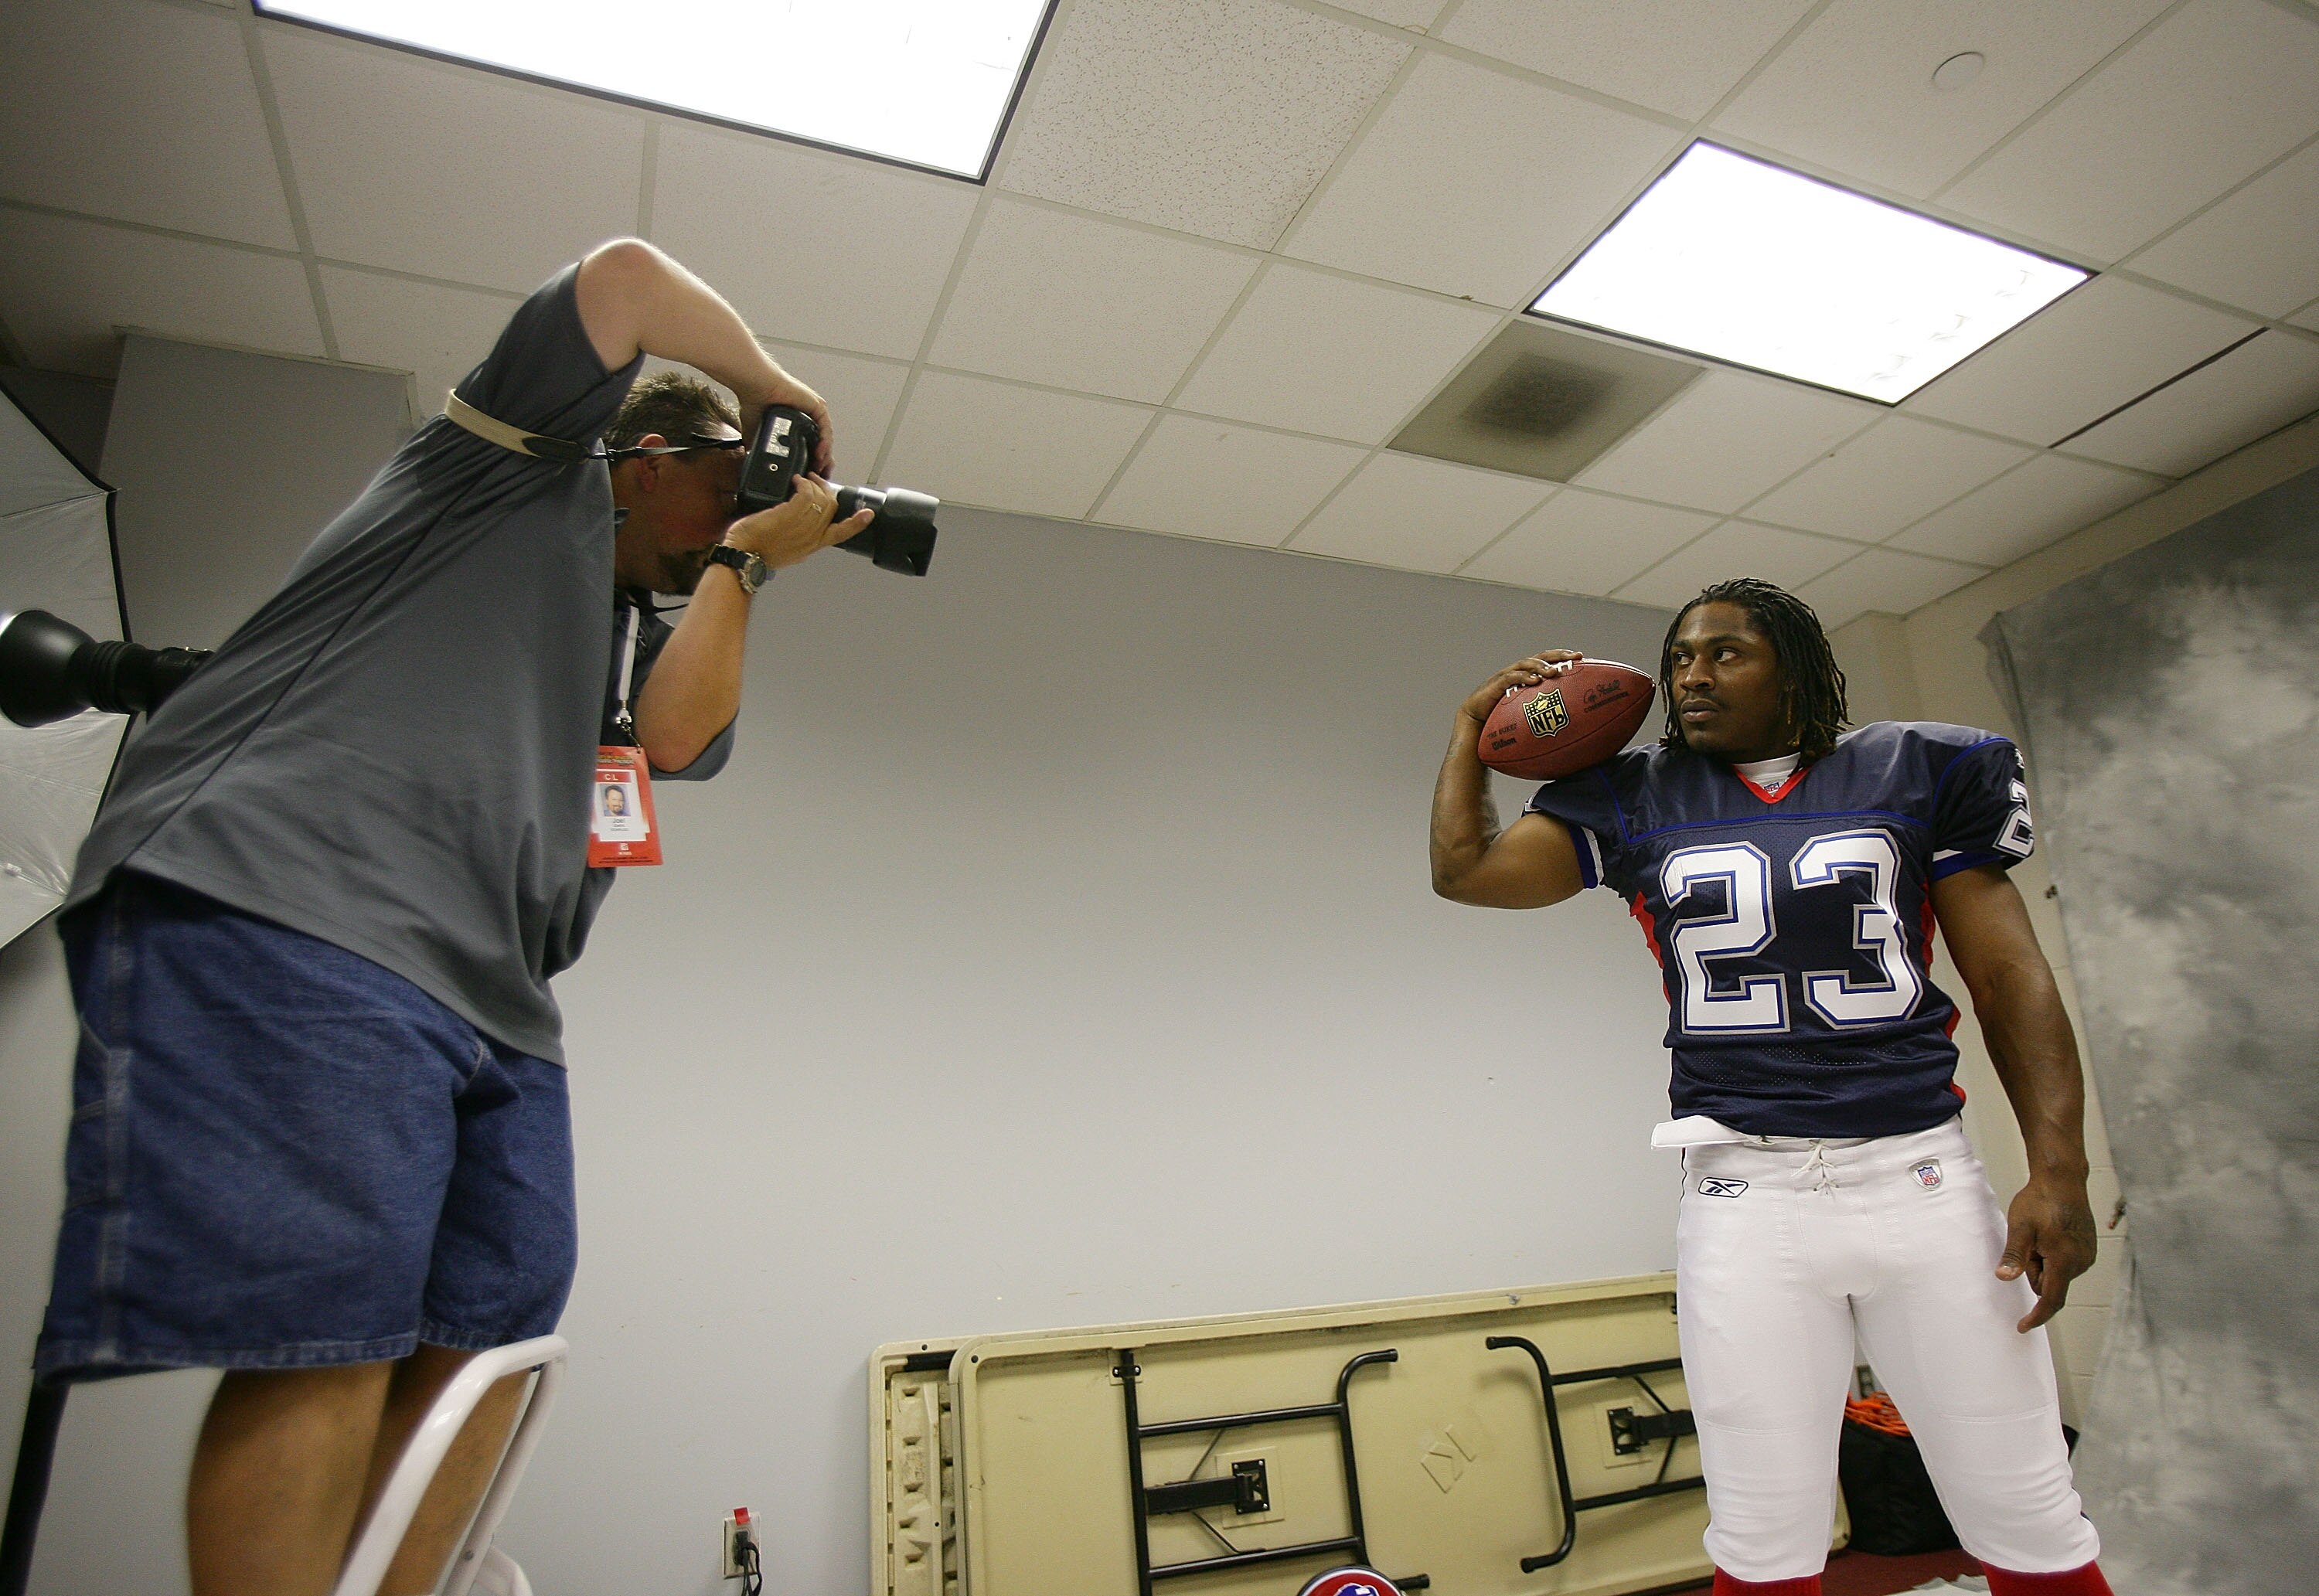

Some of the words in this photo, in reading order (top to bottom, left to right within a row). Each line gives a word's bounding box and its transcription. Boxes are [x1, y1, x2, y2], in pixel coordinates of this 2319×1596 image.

[1492, 737, 1517, 750] Wilson
[1530, 705, 1565, 733] NFL
[1992, 778, 2035, 859] 2
[1660, 829, 1924, 1036] 23
